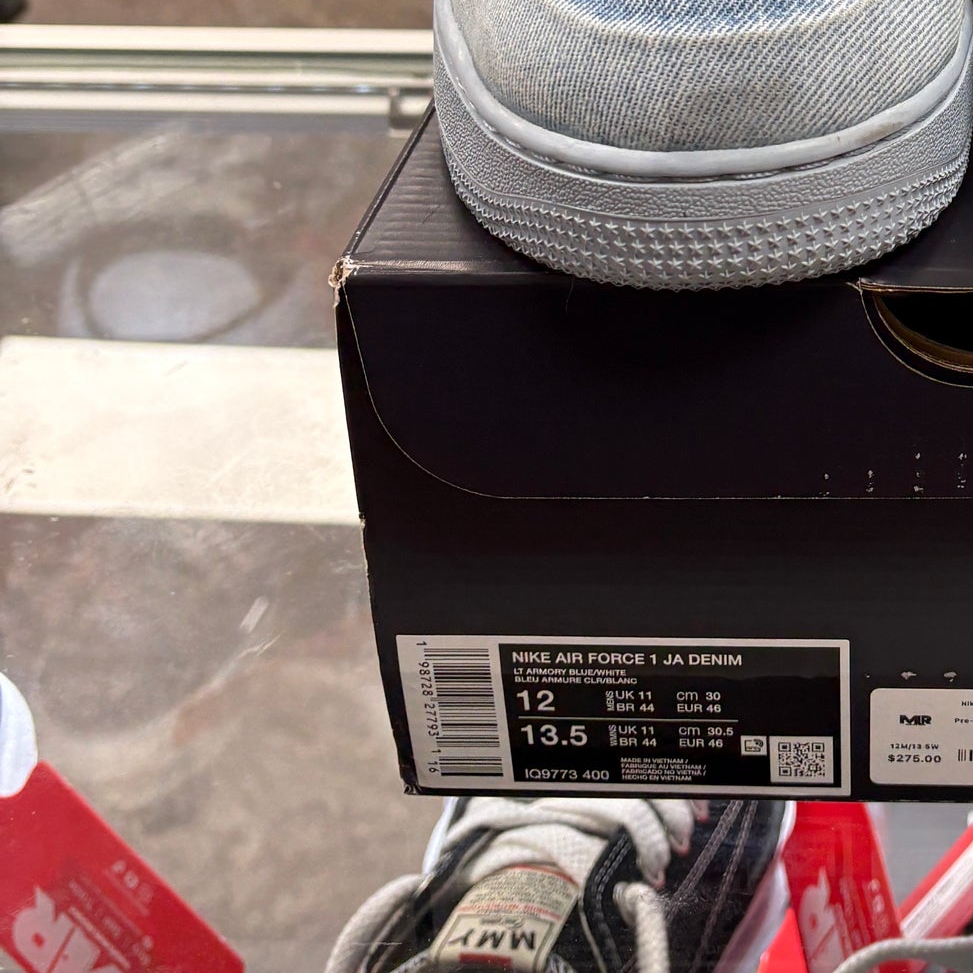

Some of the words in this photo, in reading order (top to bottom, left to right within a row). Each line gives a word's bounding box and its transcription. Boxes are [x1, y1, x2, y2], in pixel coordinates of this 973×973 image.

[512, 651, 551, 664] NIKE
[555, 652, 583, 664] AIR
[588, 652, 645, 665] FORCE
[649, 653, 657, 665] 1
[663, 653, 684, 665] JA
[688, 654, 742, 666] DENIM
[526, 668, 567, 676] ARMORY
[569, 668, 627, 677] BLUE/WHITE
[418, 661, 434, 697] 98728
[541, 676, 582, 684] ARMURE
[516, 689, 555, 711] 12
[615, 690, 635, 700] UK
[638, 691, 652, 700] 11
[676, 691, 699, 701] cm
[705, 691, 721, 701] 30
[605, 690, 615, 712] MENS
[616, 703, 635, 712] BR
[639, 703, 655, 712] 44
[677, 704, 703, 713] EUR
[706, 704, 722, 713] 46
[424, 703, 439, 737] 27793
[520, 724, 588, 746] 13.5
[618, 725, 638, 735] UK
[641, 726, 654, 735] 11
[678, 726, 701, 736] cm
[707, 727, 734, 736] 30.5
[619, 737, 638, 747] BR
[642, 738, 657, 747] 44
[679, 738, 705, 748] EUR
[708, 738, 724, 748] 46
[887, 754, 942, 764] $275.00
[427, 761, 440, 773] 16
[524, 768, 578, 780] IQ9773
[582, 769, 610, 780] 400
[448, 928, 536, 950] MMY
